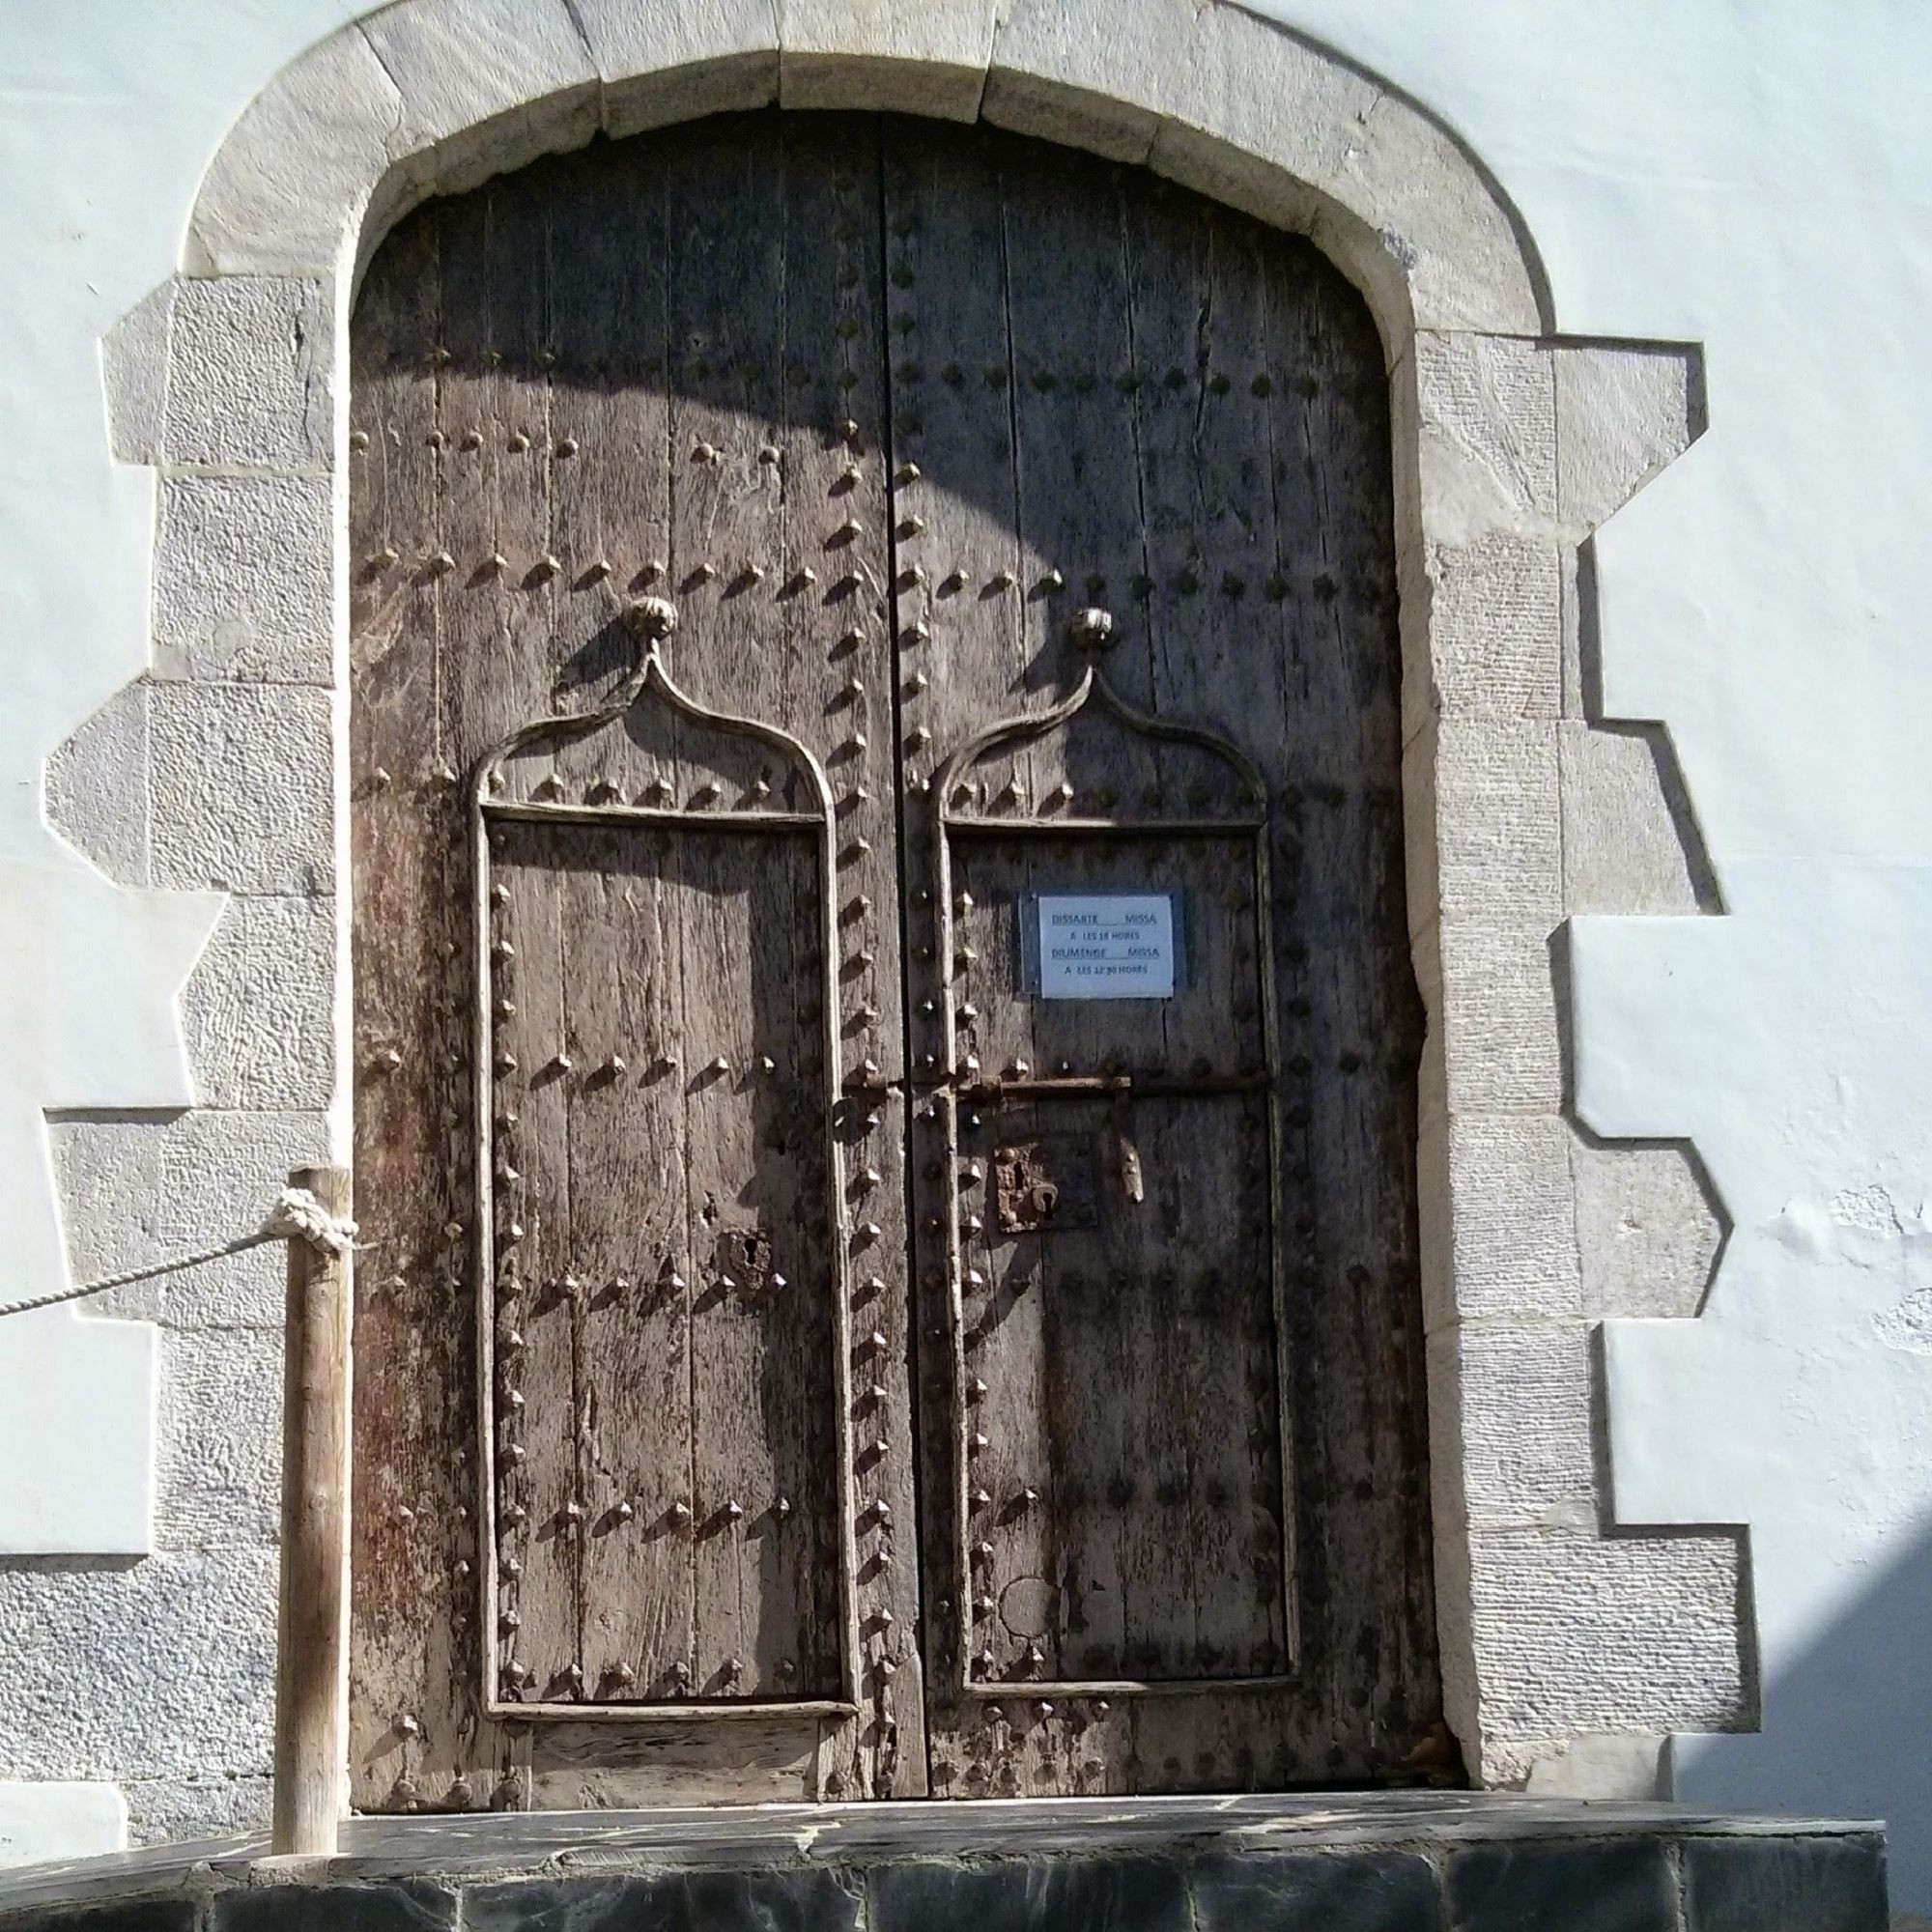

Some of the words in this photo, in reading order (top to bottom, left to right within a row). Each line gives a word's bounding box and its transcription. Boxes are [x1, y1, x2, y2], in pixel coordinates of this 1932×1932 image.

[1125, 914, 1157, 924] MISSA
[1083, 932, 1096, 941] LES
[1052, 949, 1106, 958] DIUMENGE
[1127, 948, 1160, 958] MISSA
[1119, 966, 1148, 975] HORES
